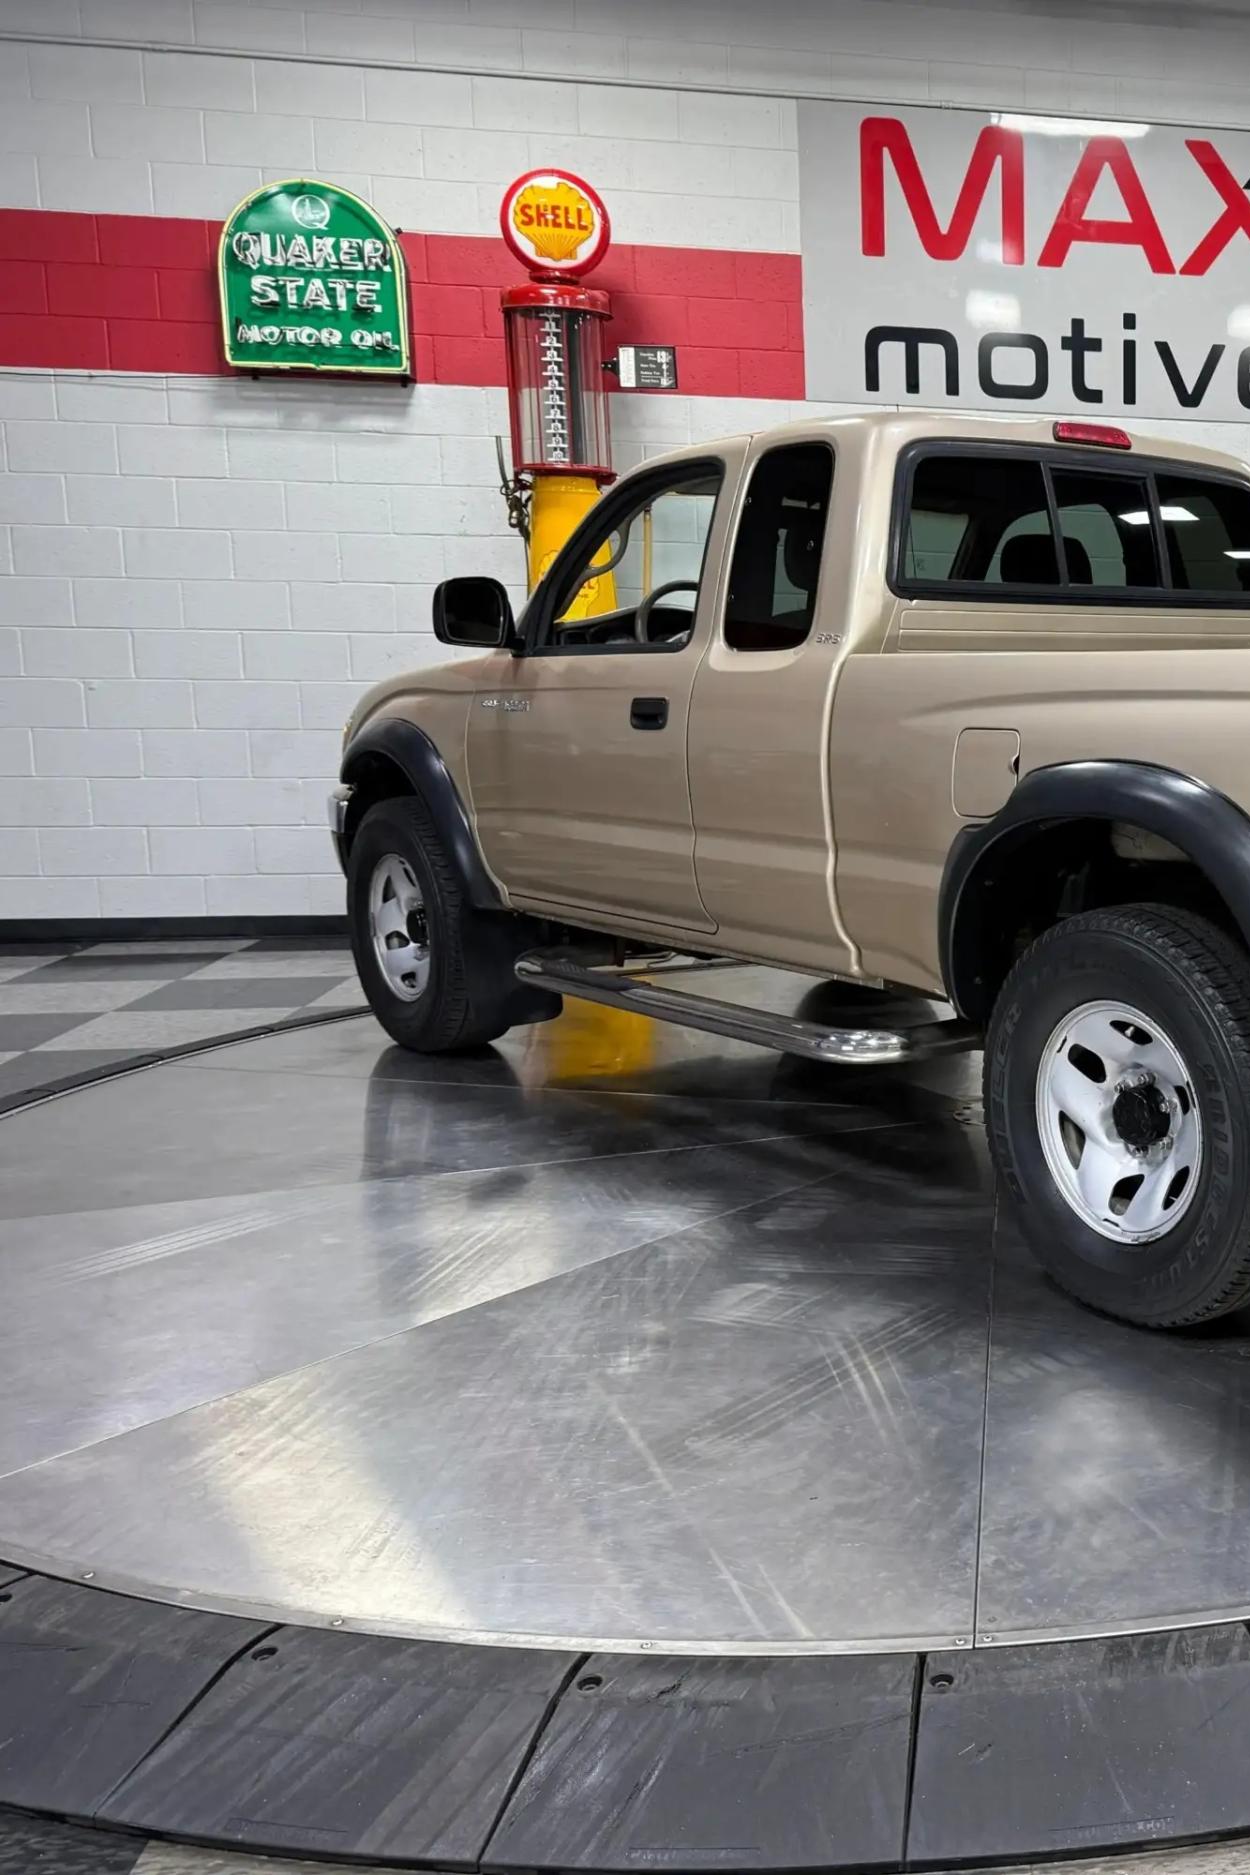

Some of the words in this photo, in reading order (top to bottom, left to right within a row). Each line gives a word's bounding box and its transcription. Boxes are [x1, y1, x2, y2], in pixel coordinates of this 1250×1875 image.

[520, 203, 589, 231] SHELL
[232, 231, 392, 272] QUAKER
[250, 274, 383, 313] STATE
[237, 324, 342, 347] MOTOR
[351, 329, 400, 350] OIL
